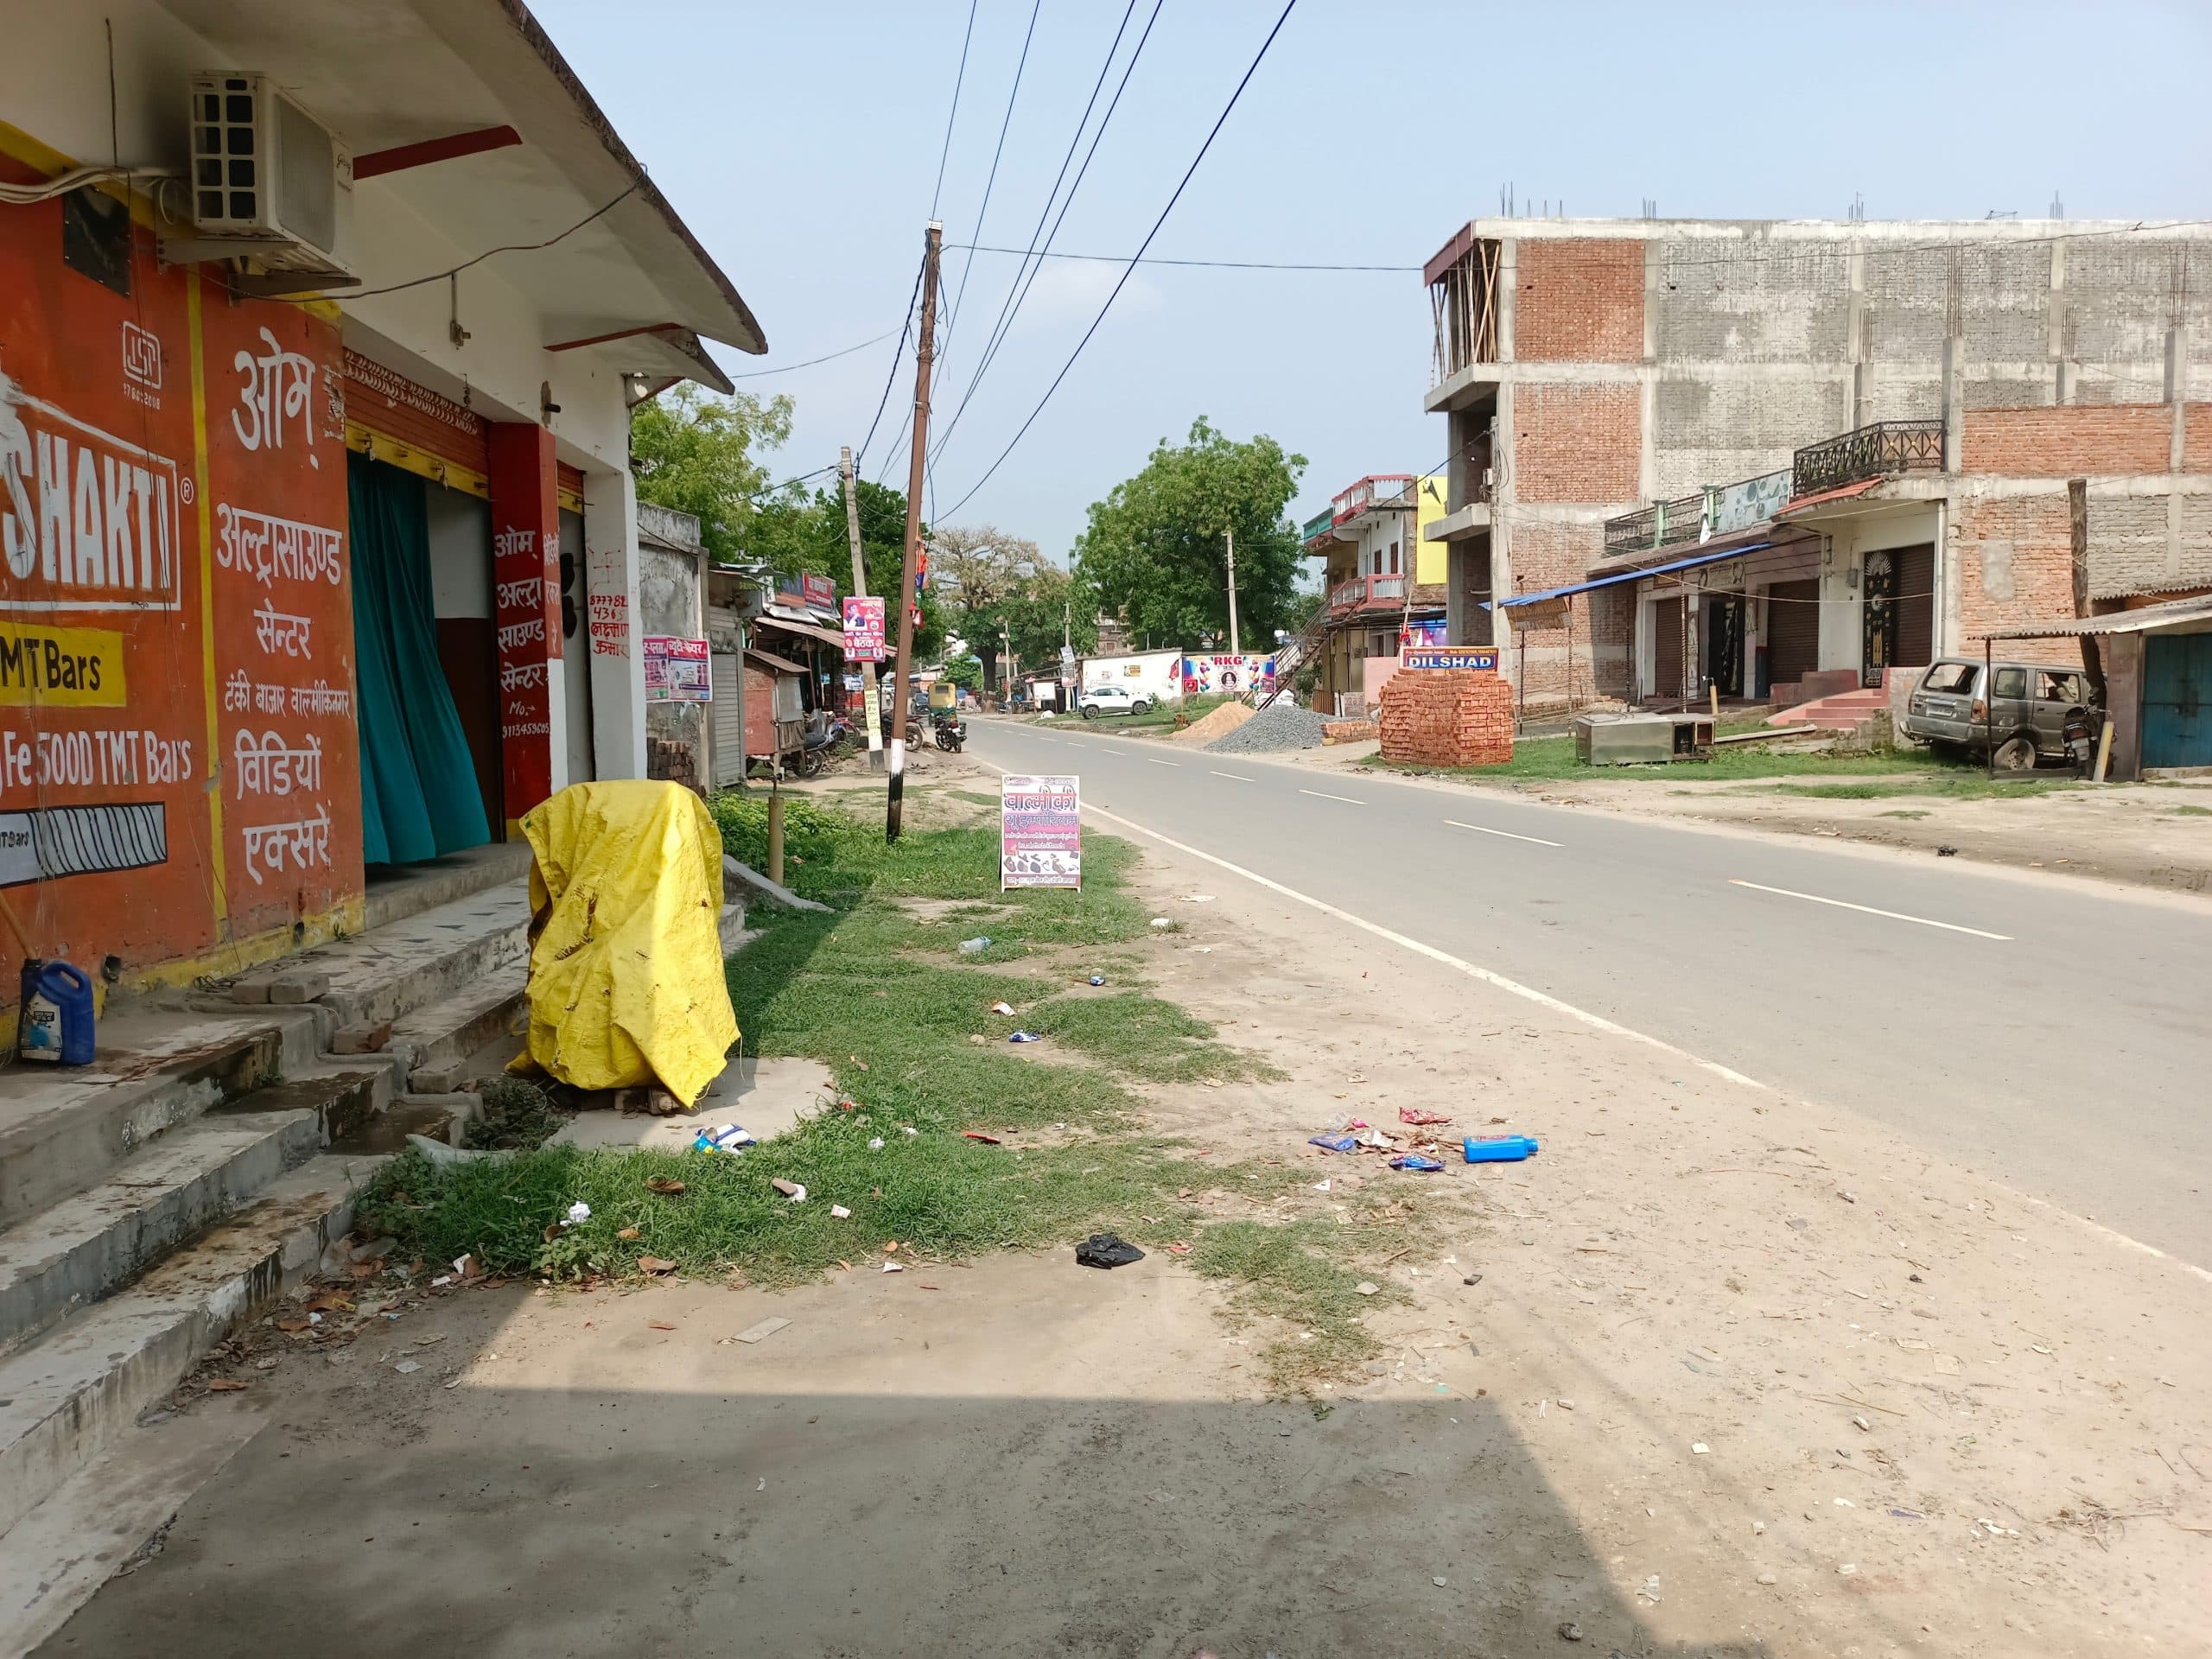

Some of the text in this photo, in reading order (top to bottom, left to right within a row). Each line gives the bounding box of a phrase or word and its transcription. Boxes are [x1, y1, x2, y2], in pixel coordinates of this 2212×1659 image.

[0, 413, 171, 592] SHAKTI
[44, 639, 101, 691] Bars
[1213, 656, 1243, 666] RKG
[1408, 656, 1492, 669] DILSHAD
[255, 683, 287, 718] बाजार
[3, 731, 32, 787] Fe
[95, 730, 139, 785] TMT
[144, 730, 192, 785] Bars
